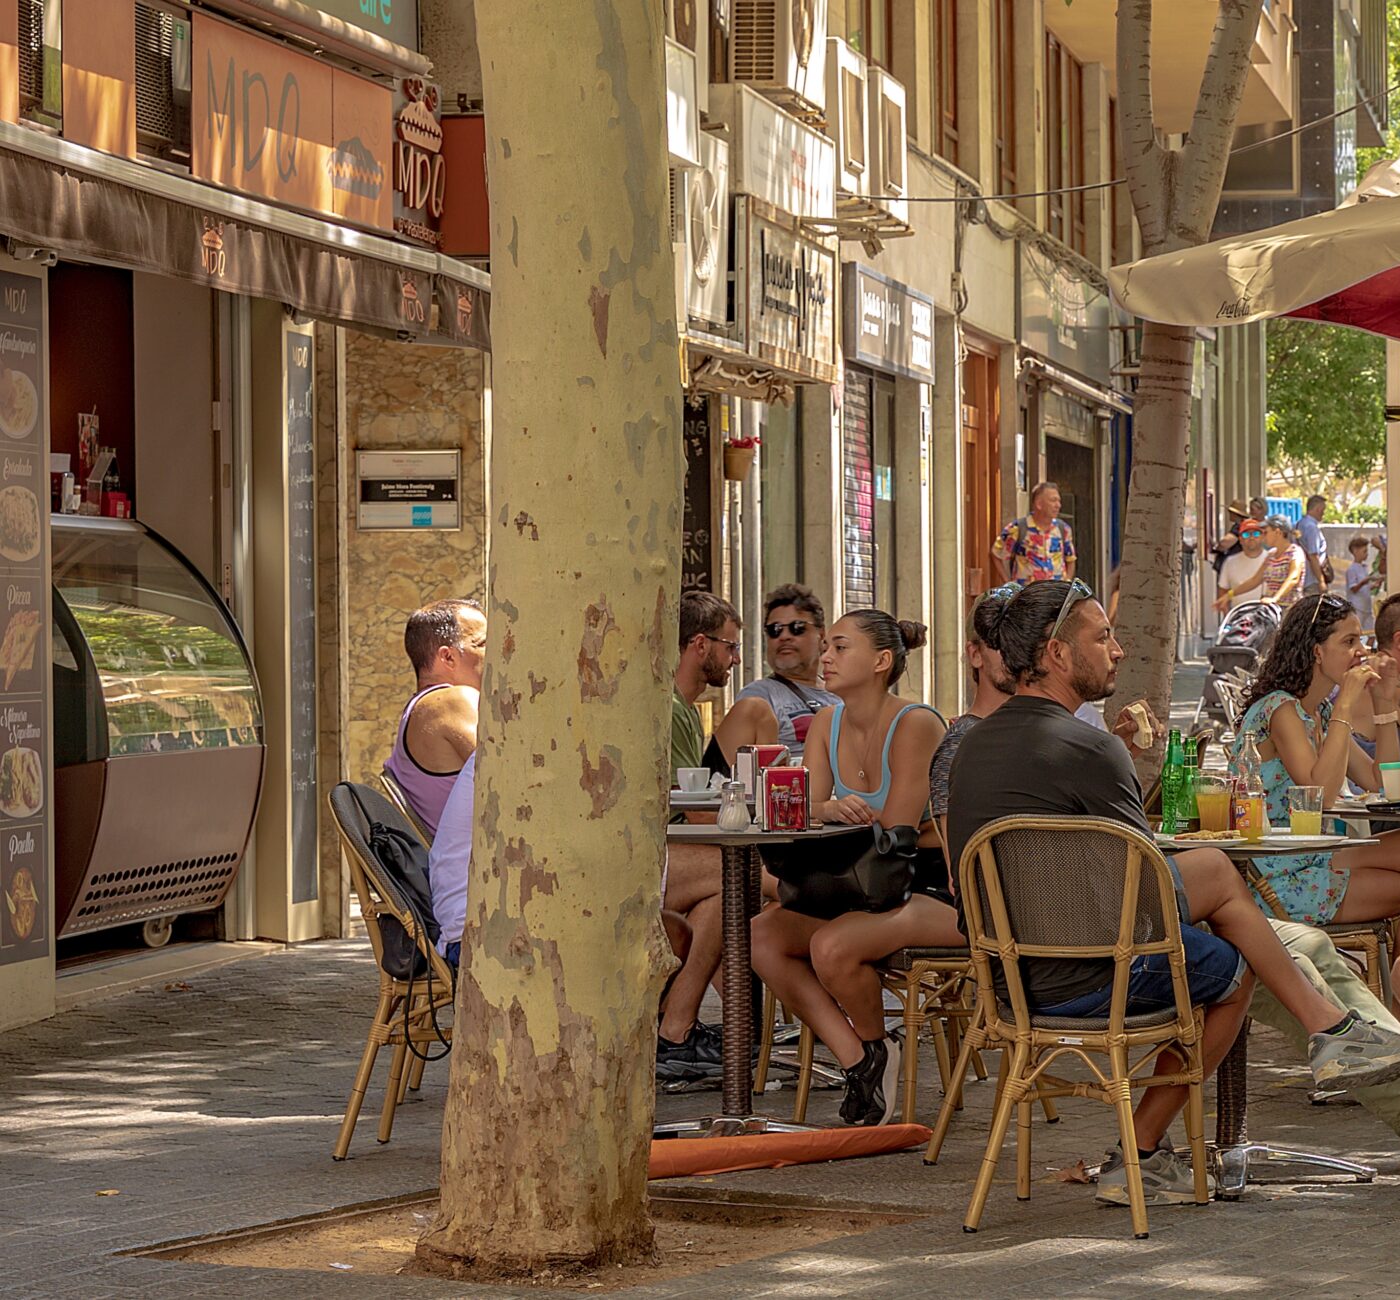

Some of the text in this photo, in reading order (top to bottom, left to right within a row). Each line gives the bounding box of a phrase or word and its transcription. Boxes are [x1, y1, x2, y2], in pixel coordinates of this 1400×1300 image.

[207, 48, 300, 184] MDQ
[399, 140, 446, 218] MDQ
[201, 246, 226, 278] MDQ
[4, 286, 28, 314] MDQ
[400, 299, 425, 323] MDQ
[6, 584, 31, 611] Pizza
[9, 831, 36, 862] Paella
